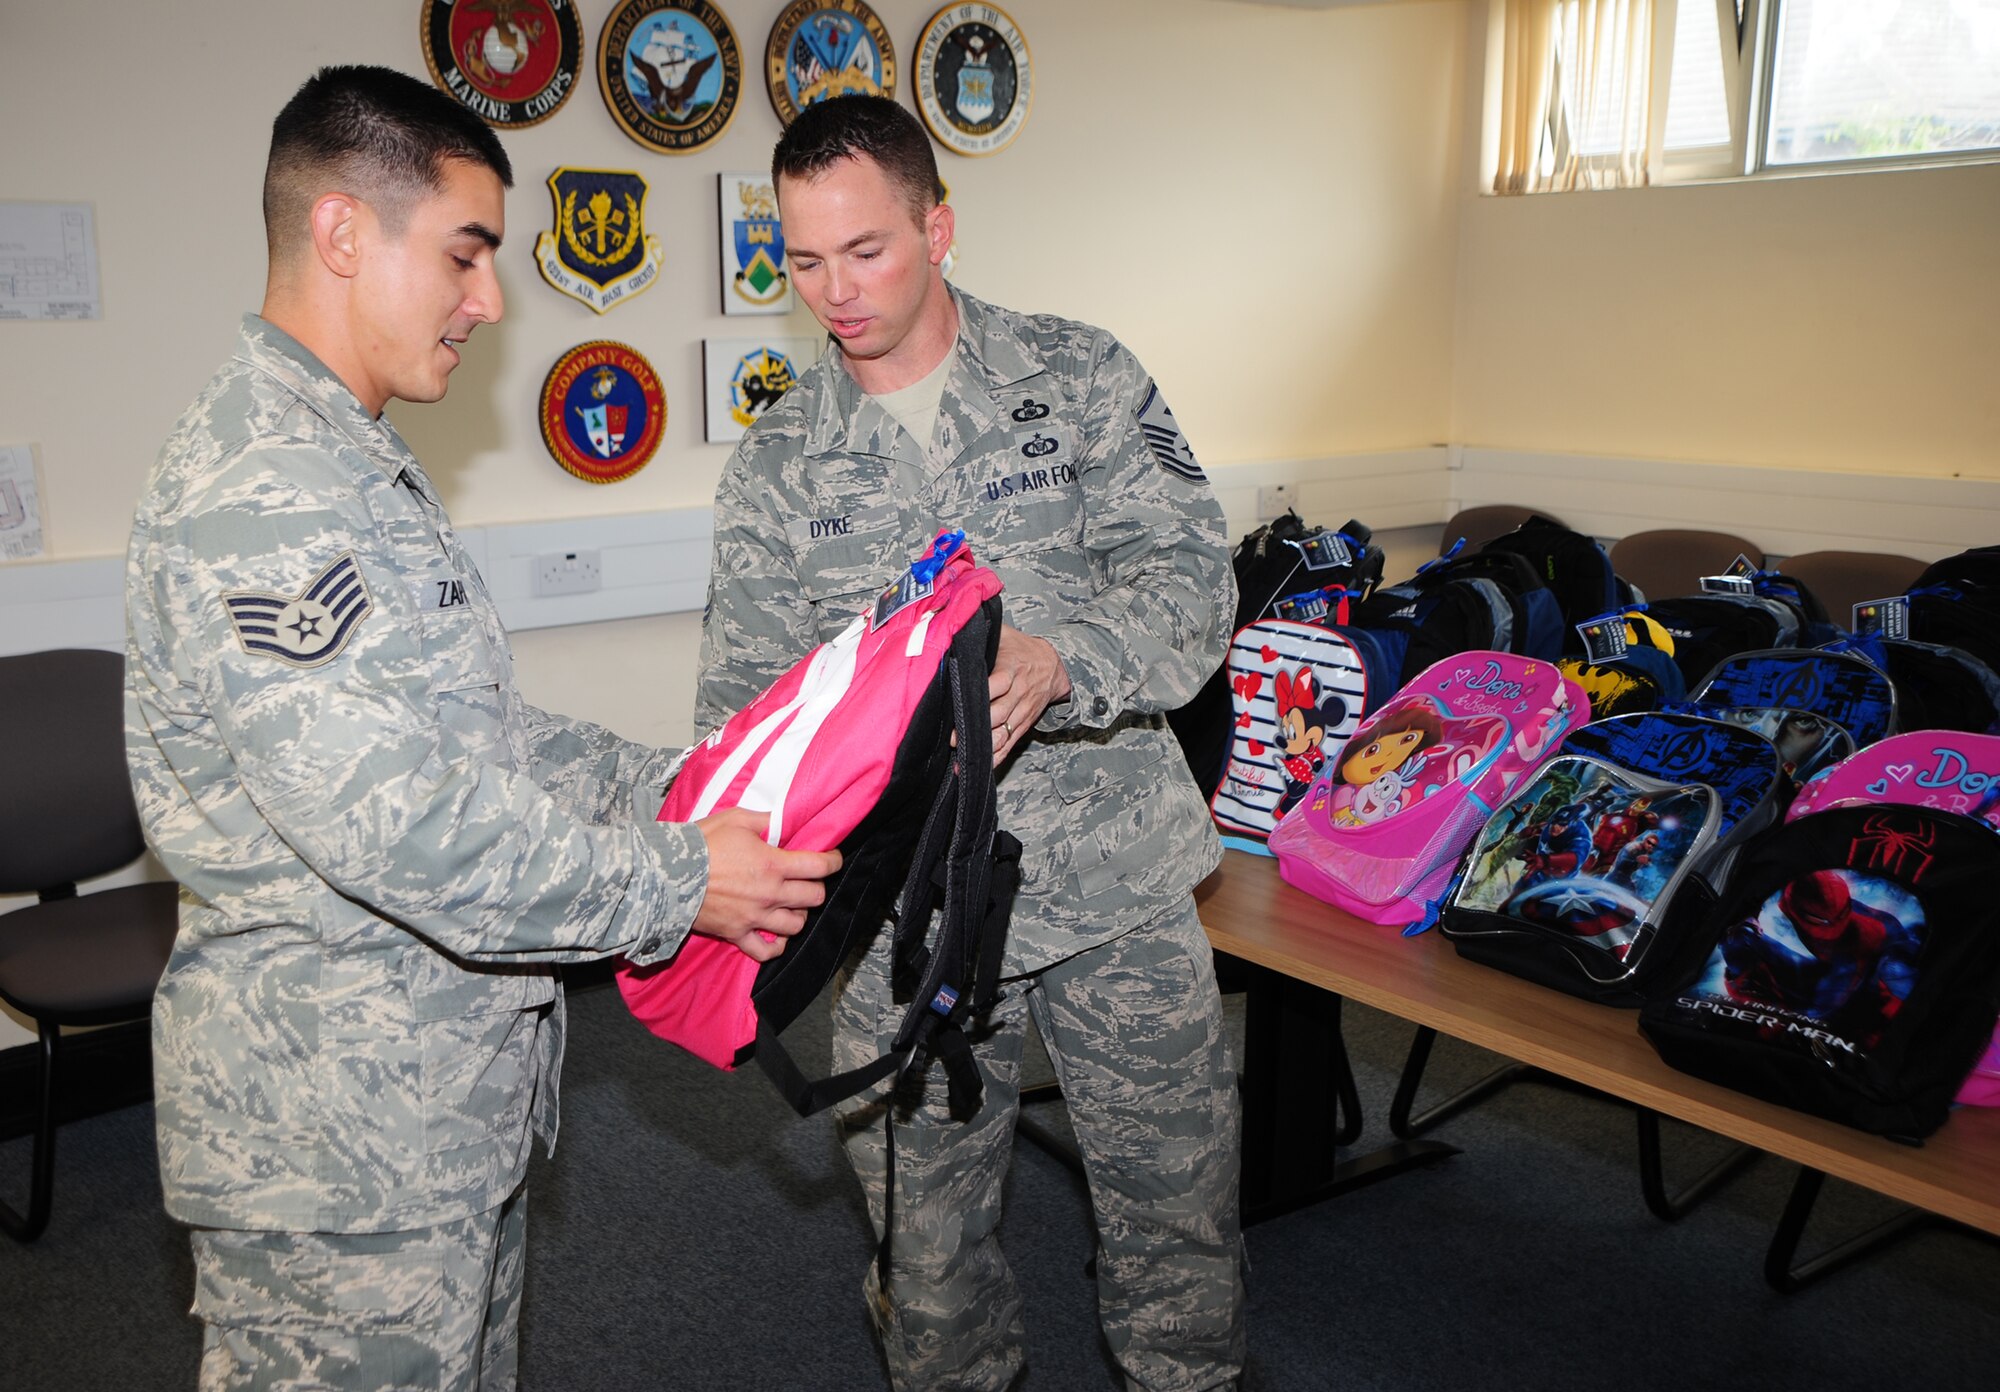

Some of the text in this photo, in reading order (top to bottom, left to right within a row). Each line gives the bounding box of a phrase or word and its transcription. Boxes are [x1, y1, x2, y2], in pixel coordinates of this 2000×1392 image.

[444, 66, 573, 121] MARINE CORPS
[575, 283, 594, 301] AIR
[555, 350, 655, 400] COMPANY GOLF
[986, 461, 1078, 501] U.S. AIR FOR
[810, 515, 852, 539] DYKE
[1465, 660, 1523, 699] Dora
[1915, 747, 2000, 795] Dor
[1675, 997, 1857, 1053] SPIDER-MAN
[1744, 1001, 1828, 1028] AMAZING
